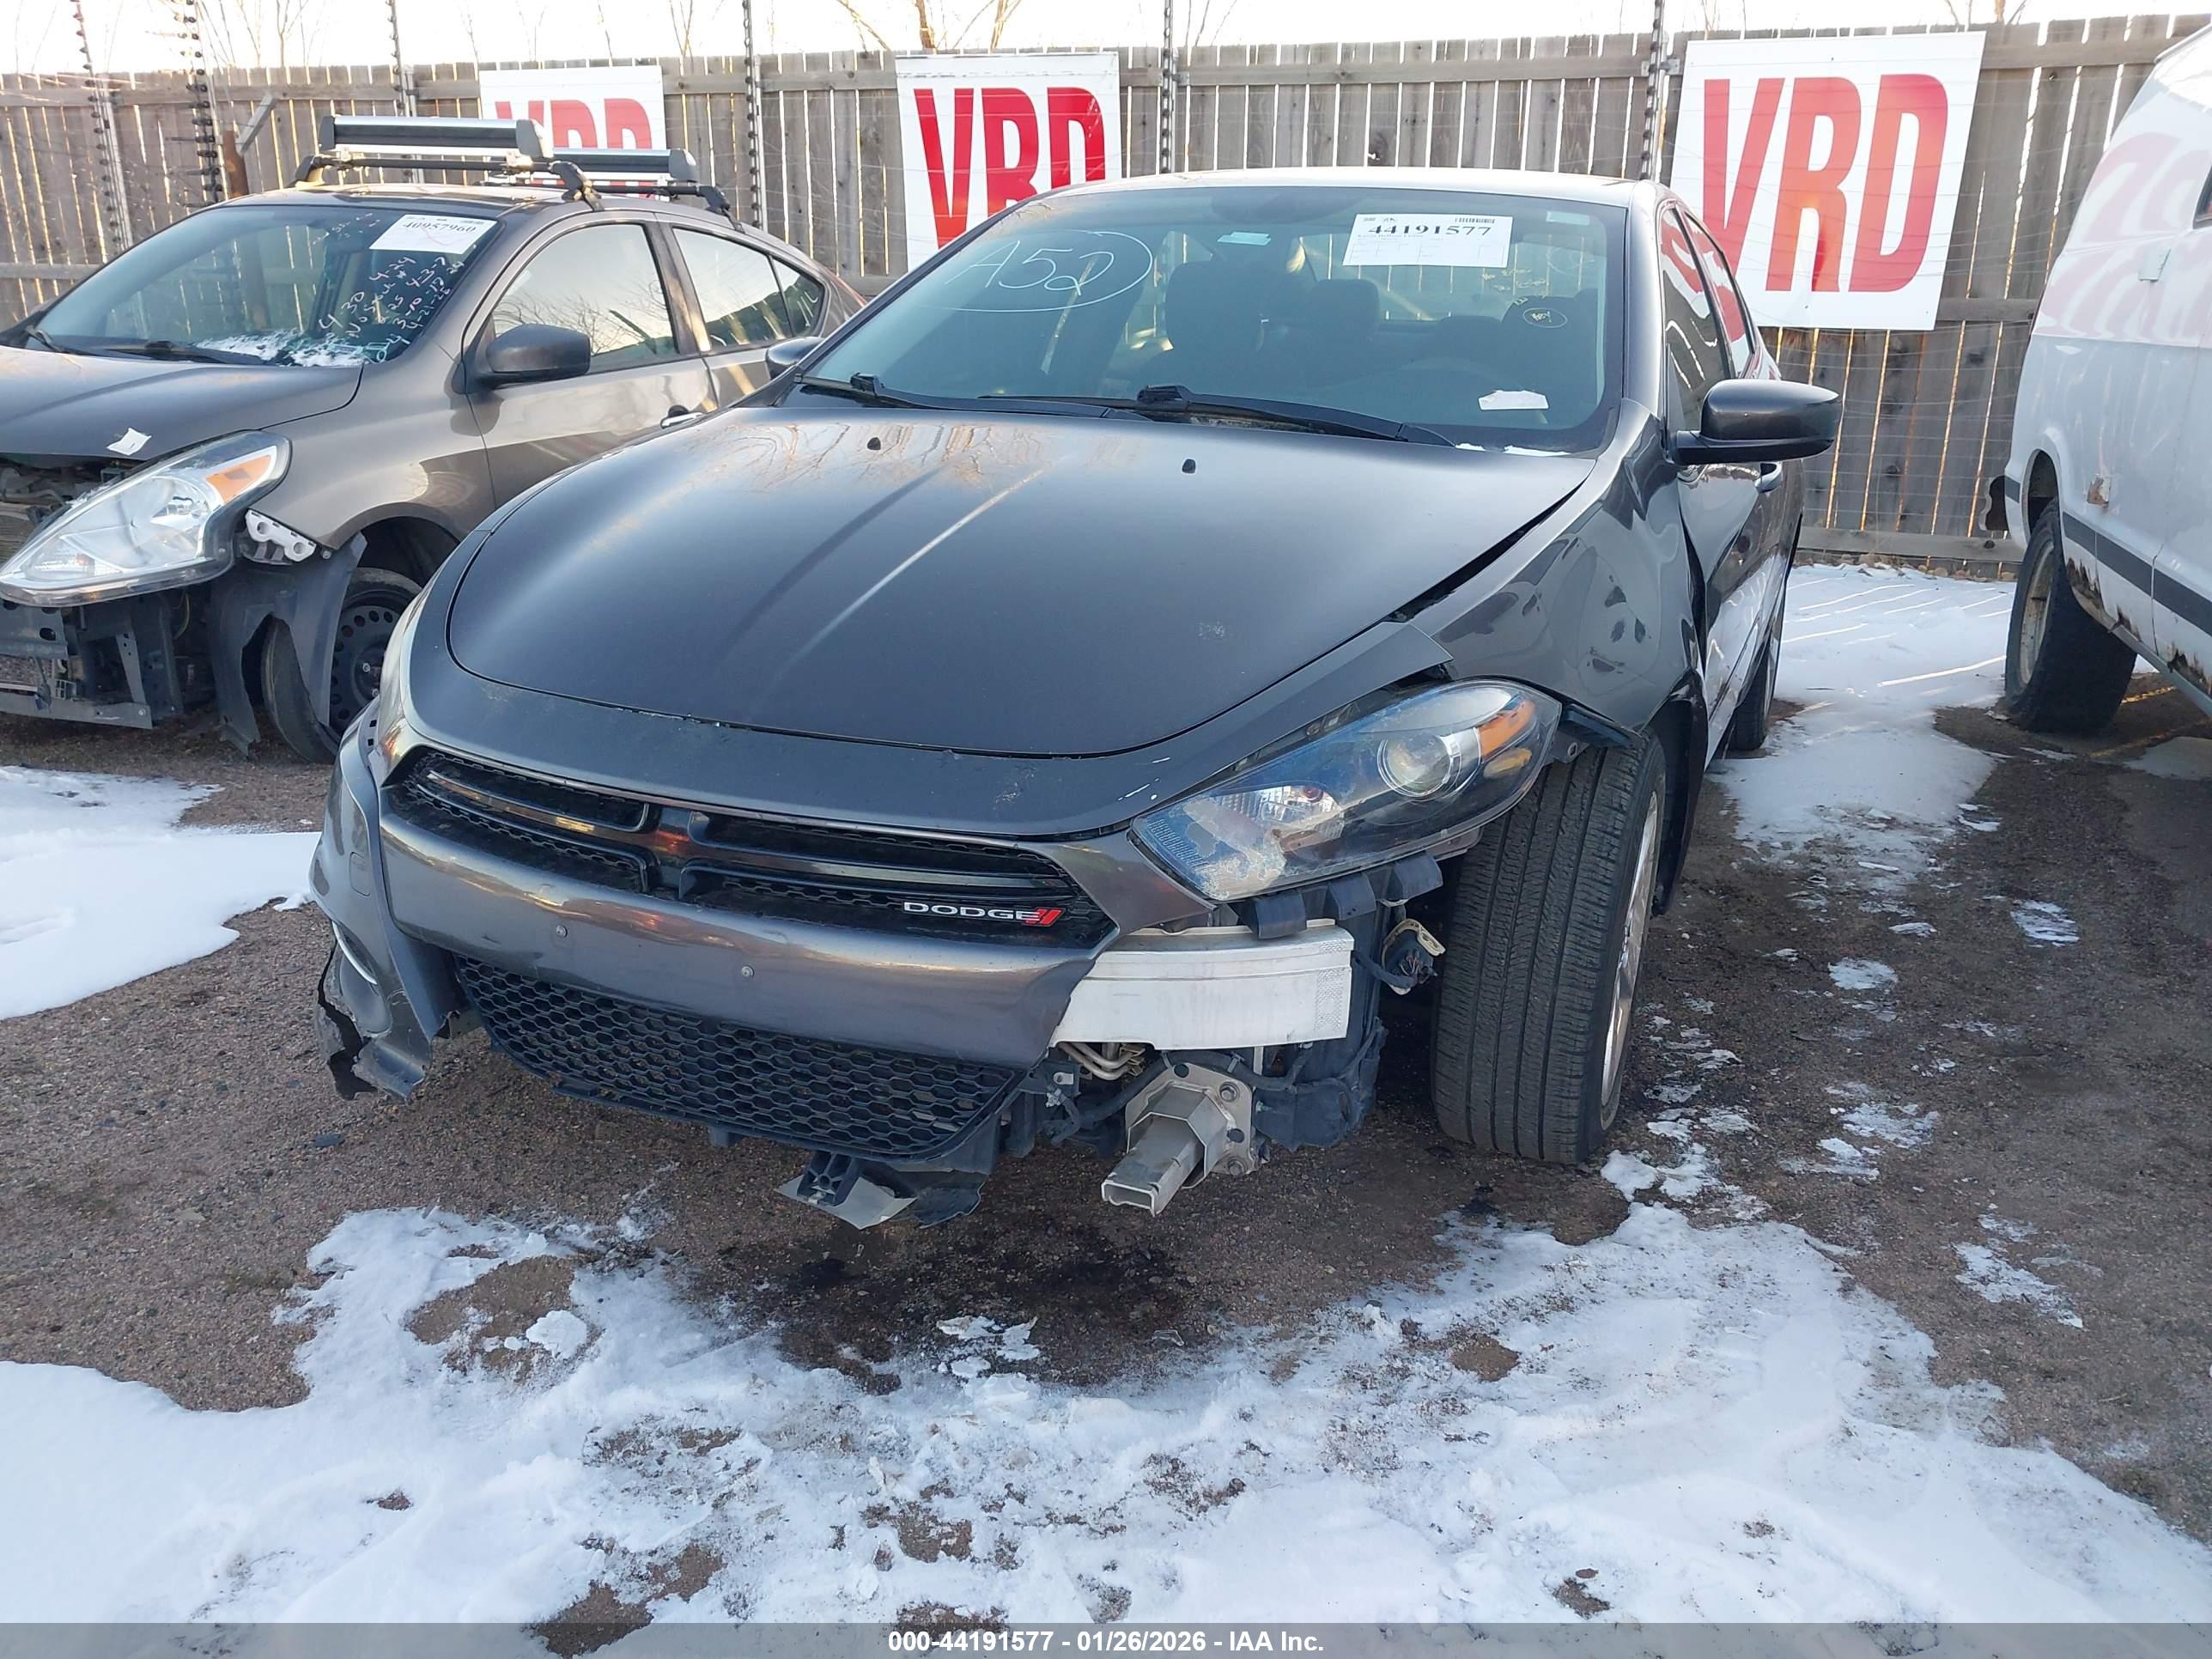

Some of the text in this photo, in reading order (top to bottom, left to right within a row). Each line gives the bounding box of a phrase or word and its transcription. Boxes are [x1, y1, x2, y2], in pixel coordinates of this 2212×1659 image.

[913, 86, 1106, 250] VRD
[1705, 73, 1948, 293] VRD
[403, 220, 477, 234] 40957960
[1368, 224, 1492, 236] 44191577
[945, 240, 1115, 296] A52
[903, 902, 1041, 922] DODGE
